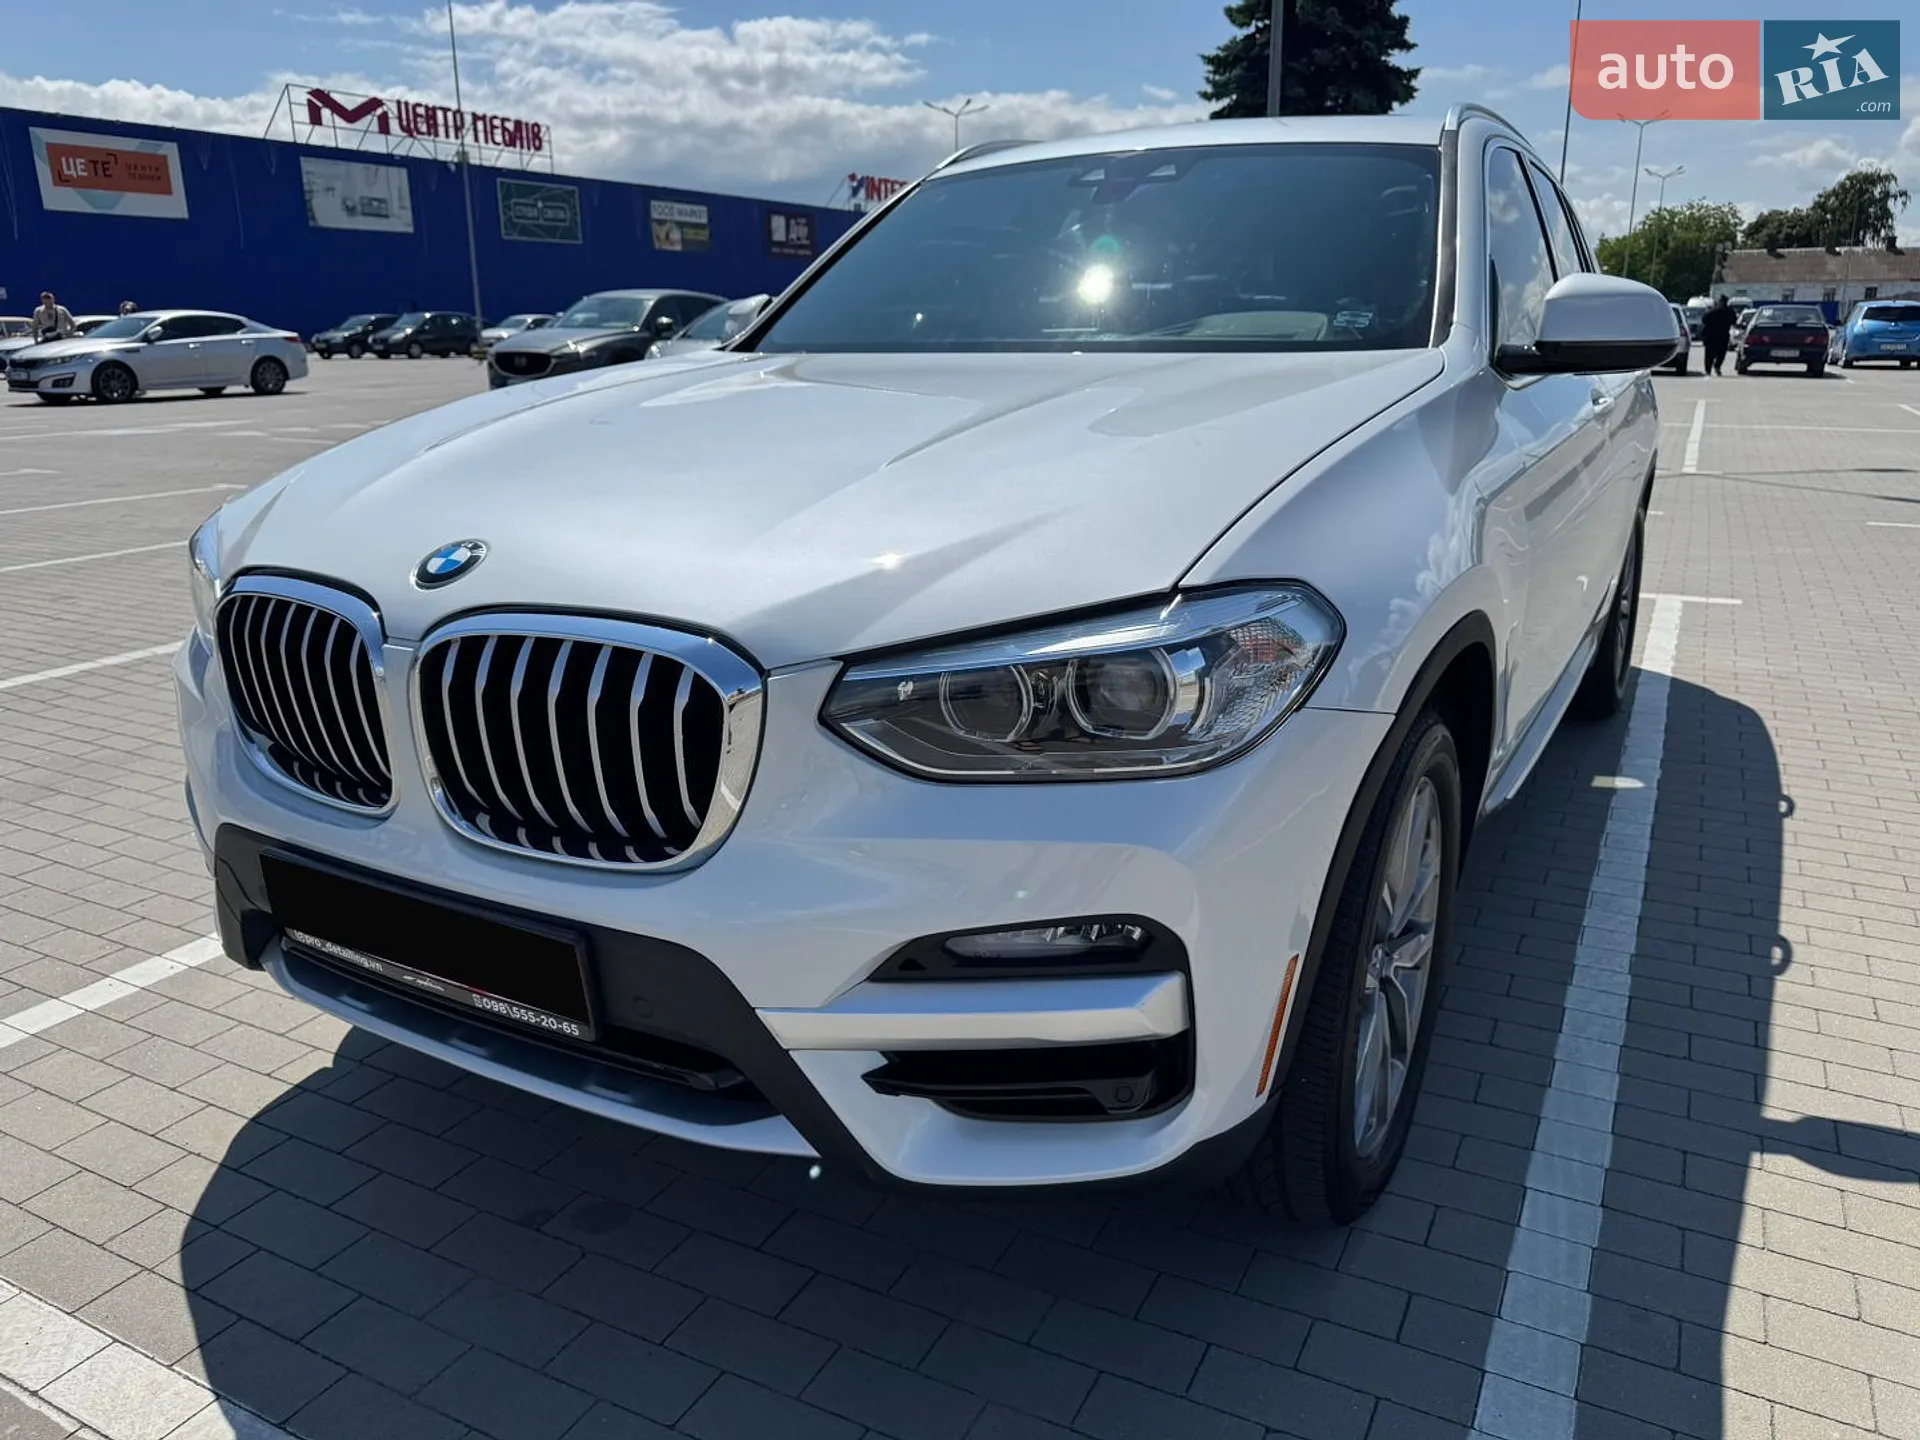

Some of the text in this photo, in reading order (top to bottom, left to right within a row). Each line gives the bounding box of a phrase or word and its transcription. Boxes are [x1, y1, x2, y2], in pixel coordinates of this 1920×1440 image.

[397, 98, 465, 141] ЦЕНТР
[471, 111, 543, 151] МЕБЛІВ
[60, 155, 113, 178] ЦЕТЕ
[865, 175, 907, 202] INTE
